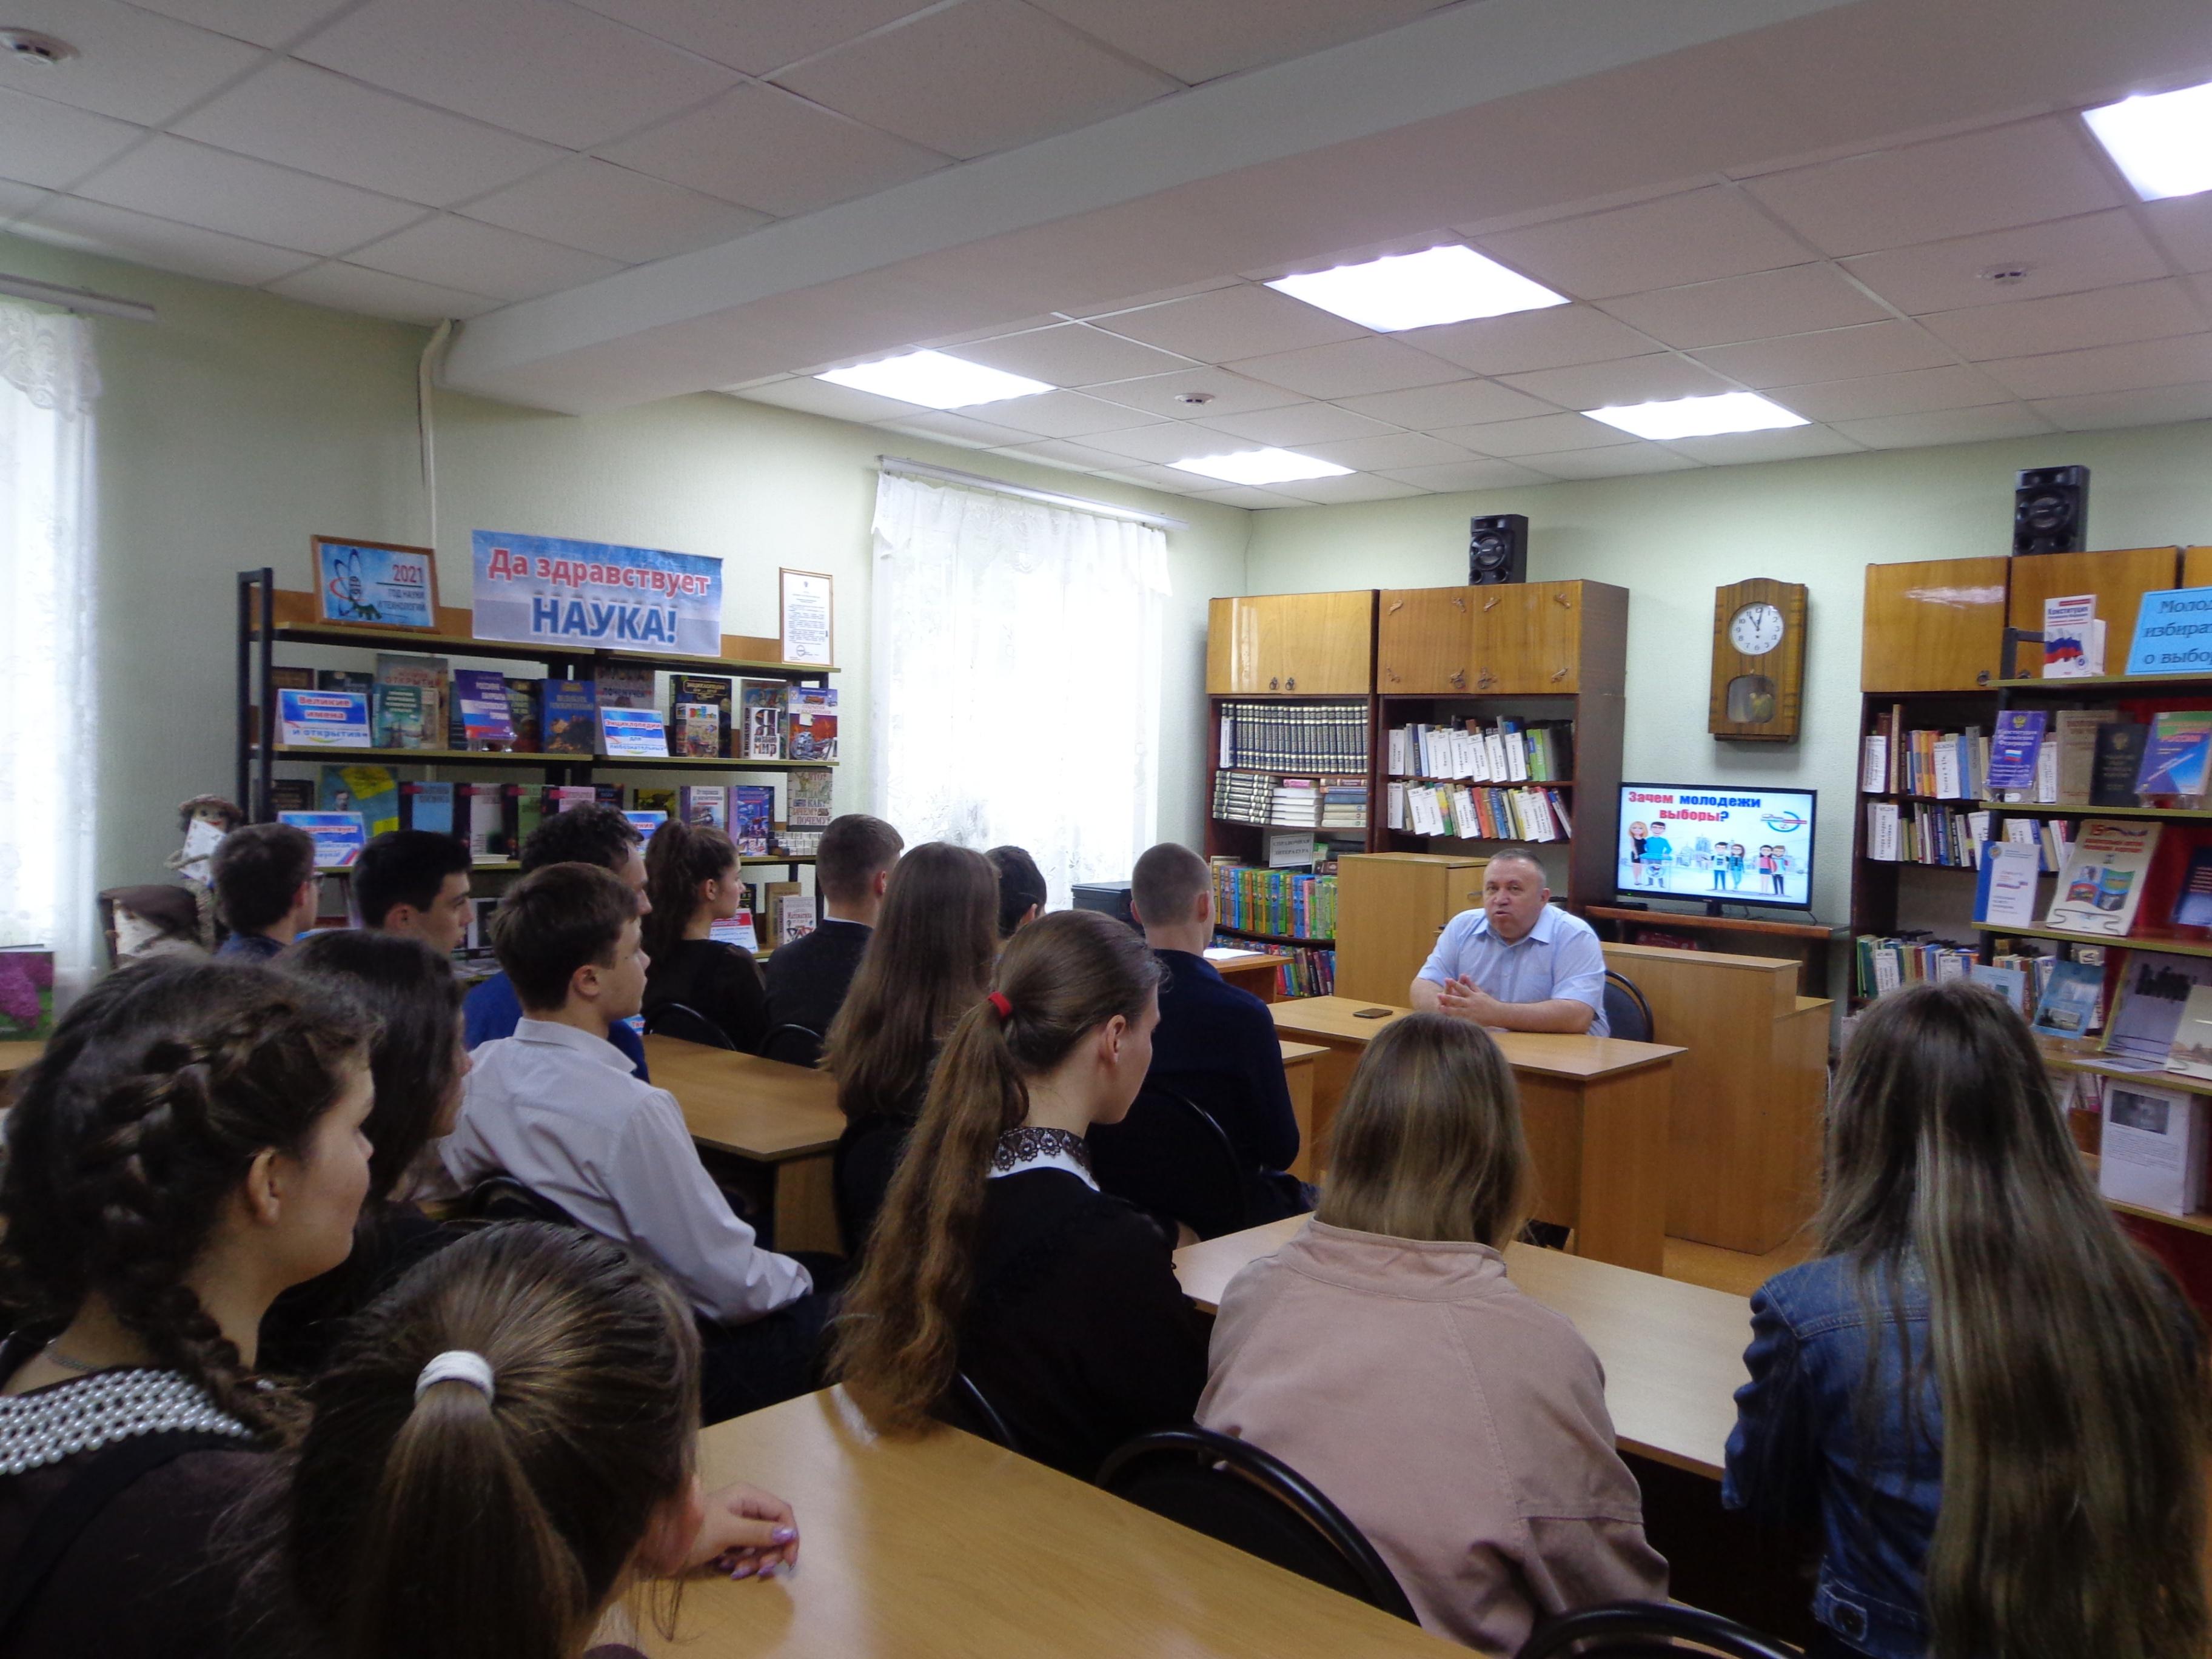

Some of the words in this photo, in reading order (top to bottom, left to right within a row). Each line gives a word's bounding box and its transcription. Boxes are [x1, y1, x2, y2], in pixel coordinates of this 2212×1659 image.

[392, 564, 423, 583] 2021
[487, 548, 529, 581] Да
[536, 557, 711, 598] здравствует
[532, 596, 677, 645] НАУКА!
[2144, 654, 2154, 665] о
[299, 696, 350, 707] Великие
[306, 711, 345, 720] имена
[1628, 791, 1674, 804] Зачем
[1679, 794, 1761, 808] молодежи
[1659, 809, 1730, 822] выборы?
